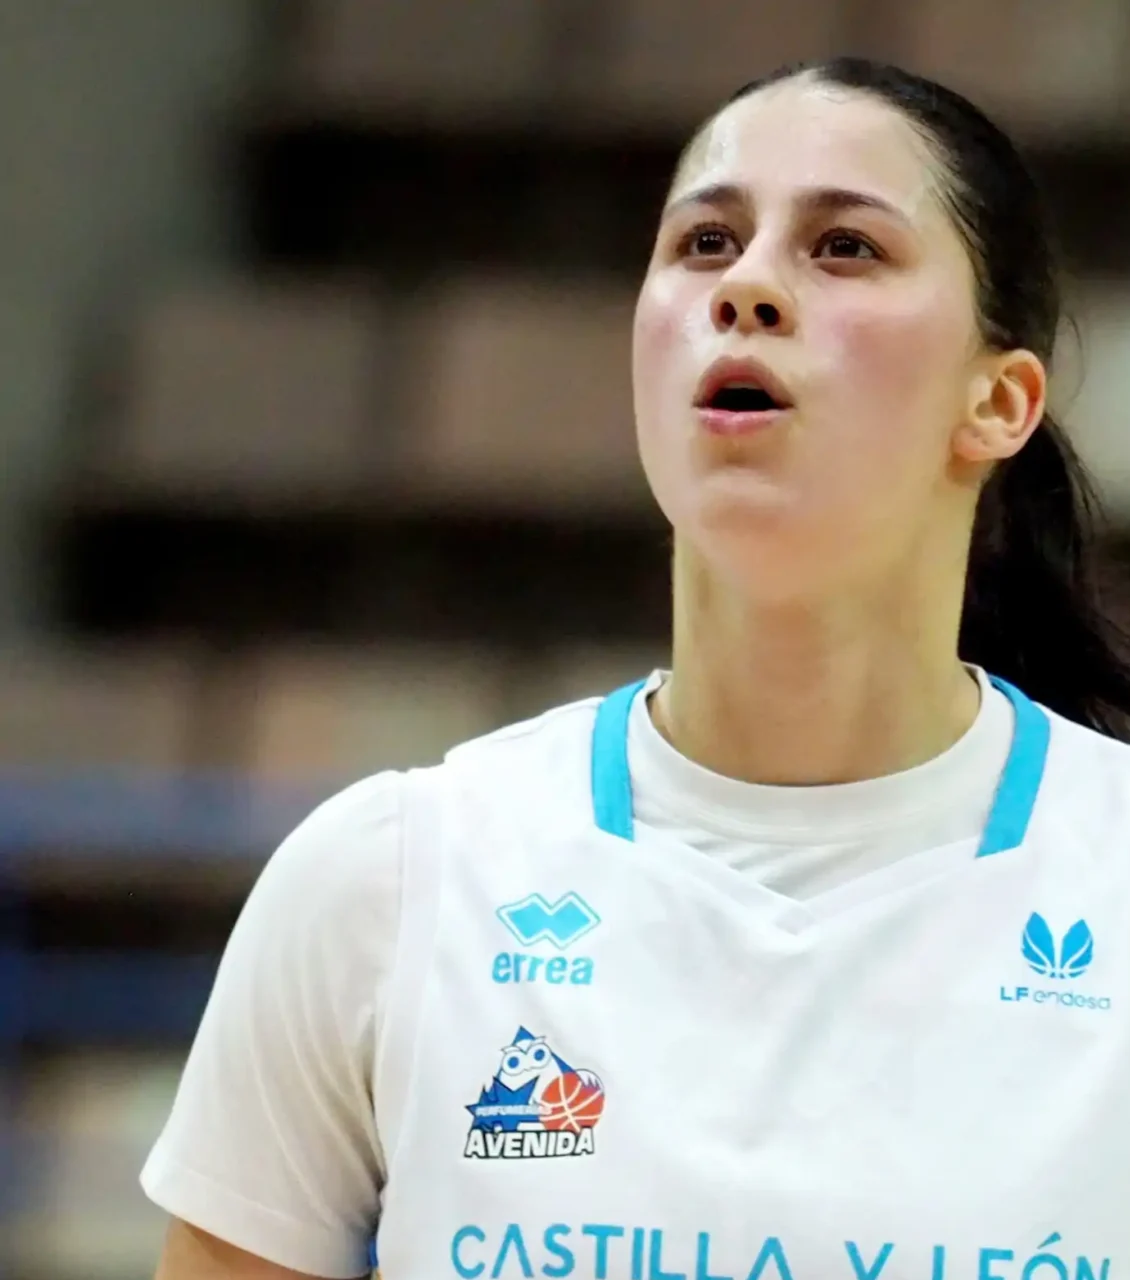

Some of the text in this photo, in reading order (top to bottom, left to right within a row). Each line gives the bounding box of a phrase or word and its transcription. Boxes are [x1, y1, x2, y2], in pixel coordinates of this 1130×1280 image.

[491, 951, 594, 987] errea
[999, 985, 1112, 1010] LF endesa
[464, 1127, 596, 1159] AVENIDA
